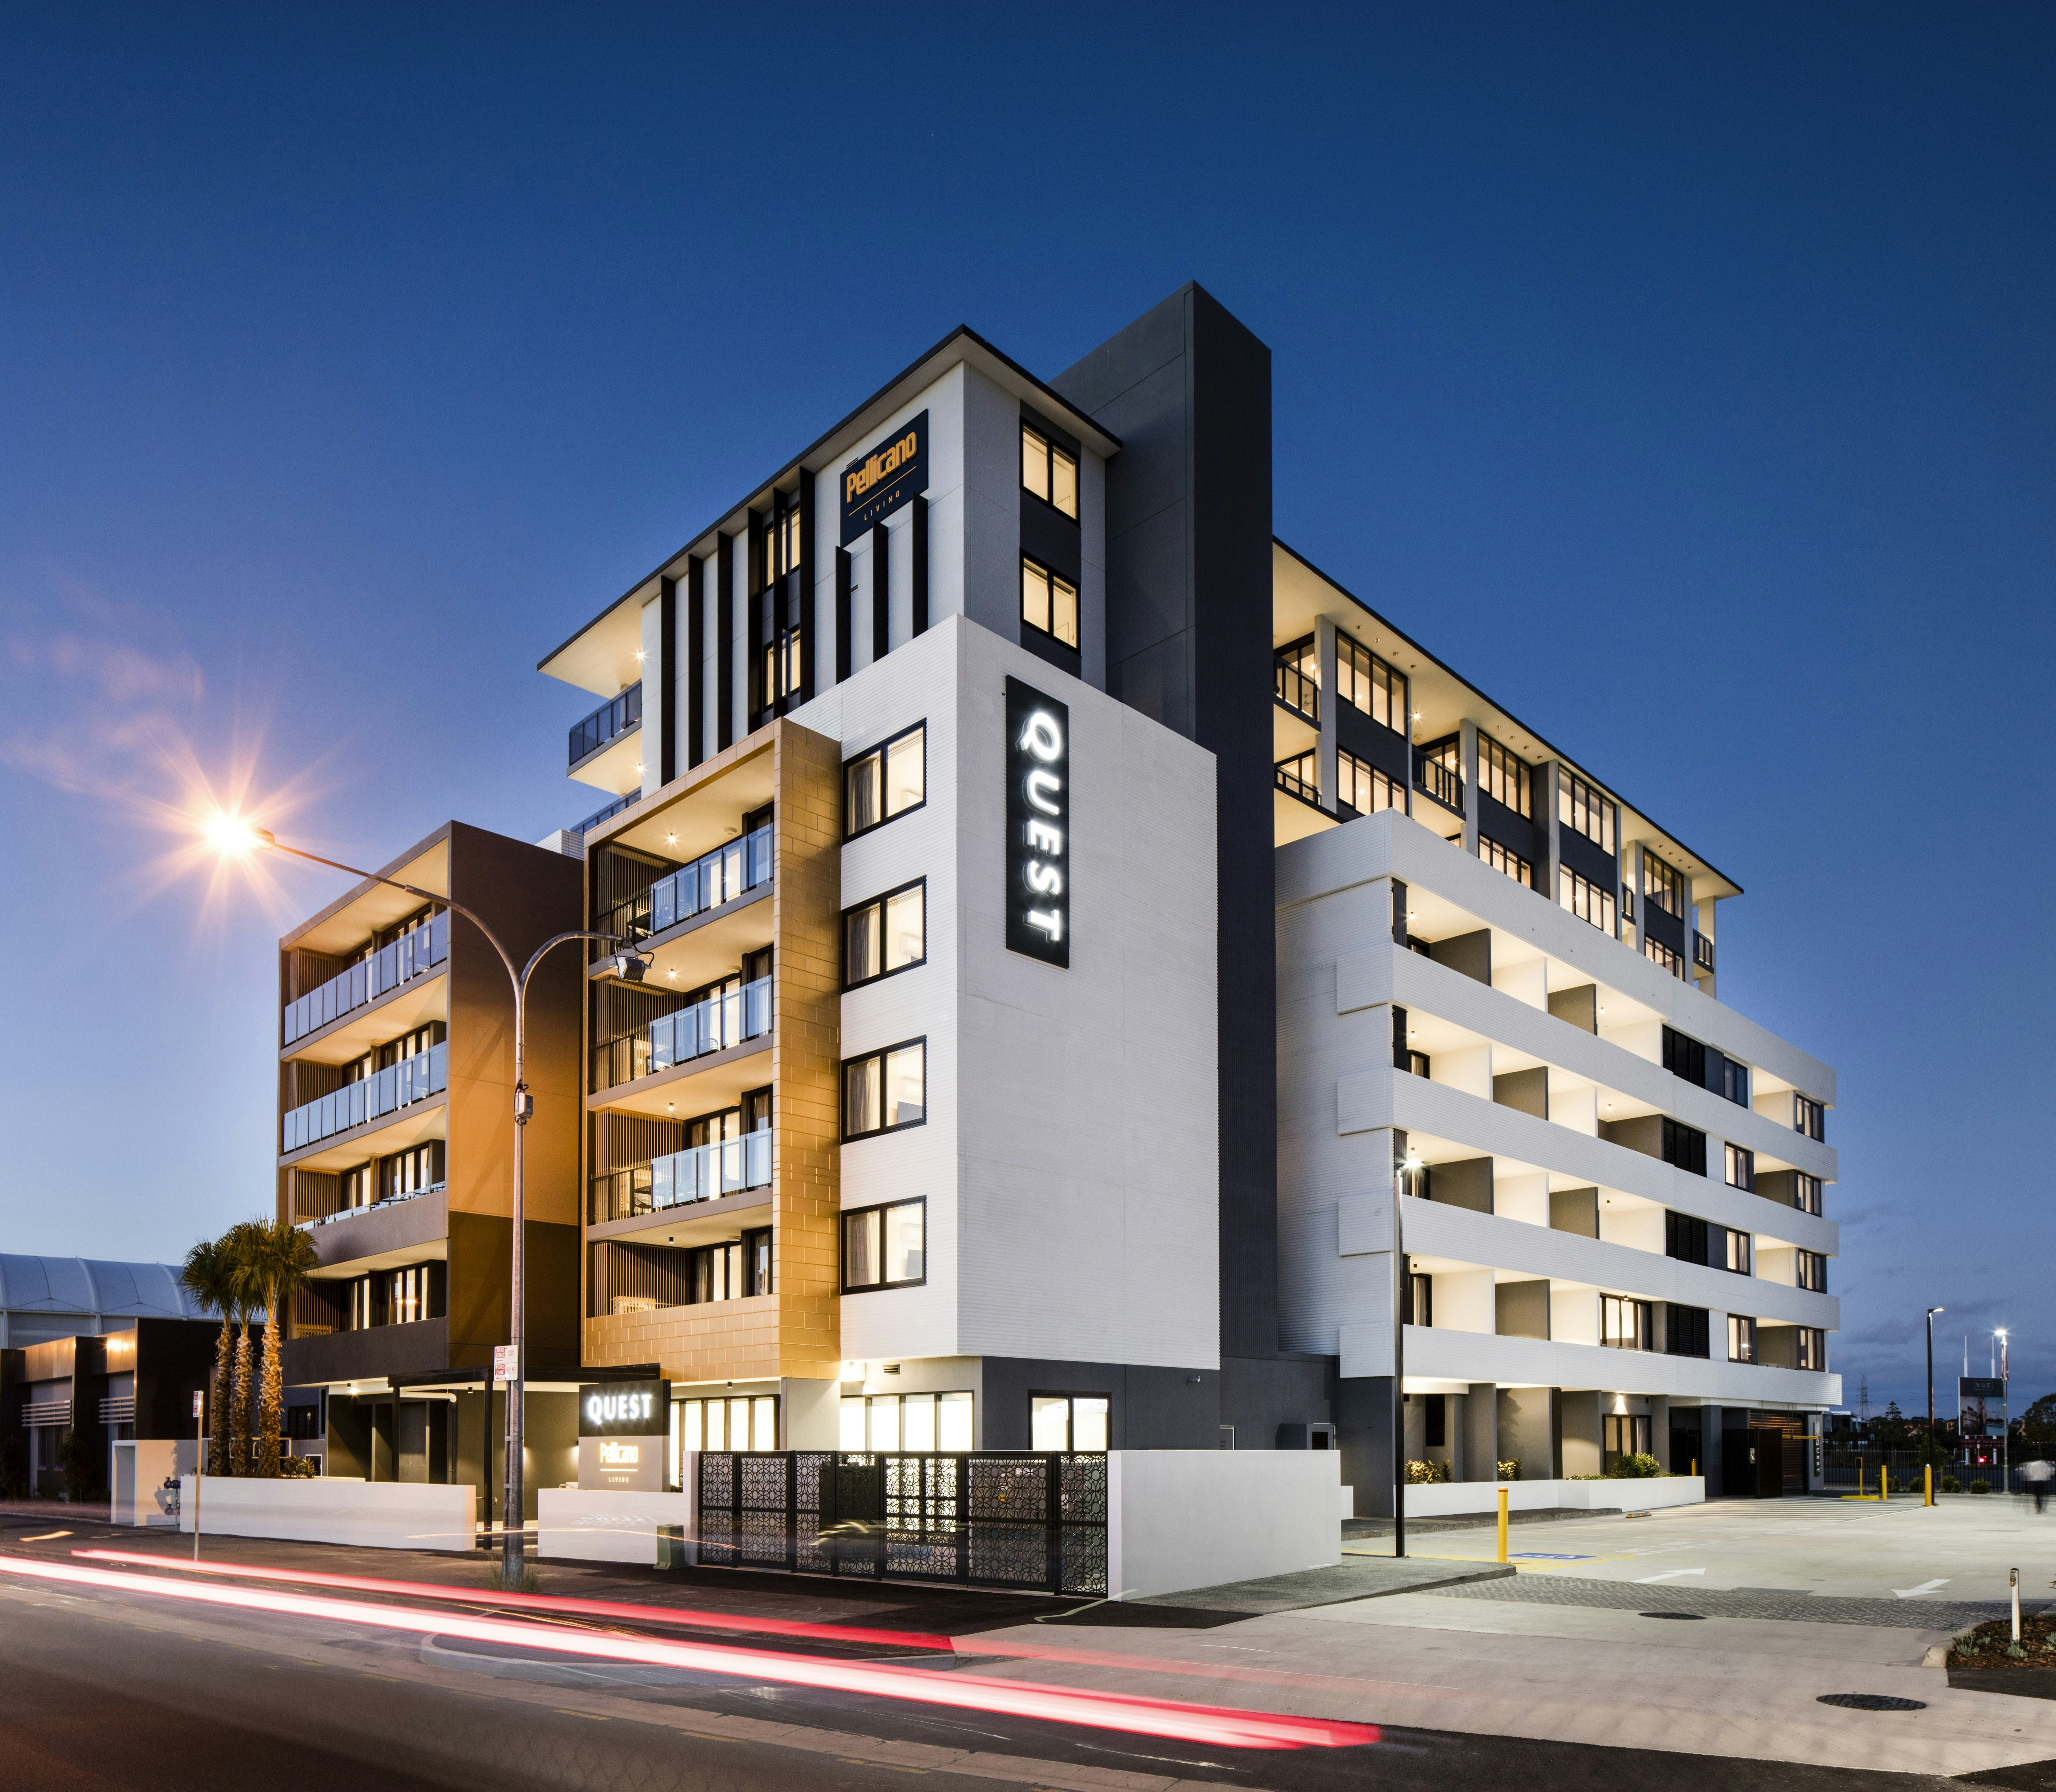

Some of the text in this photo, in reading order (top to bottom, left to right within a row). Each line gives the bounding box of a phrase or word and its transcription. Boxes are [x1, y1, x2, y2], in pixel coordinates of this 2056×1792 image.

[847, 432, 917, 504] Pellicano
[864, 490, 900, 520] LIVING
[1020, 712, 1060, 942] QUEST
[588, 1395, 652, 1425] QUEST
[600, 1442, 638, 1463] Pellicano
